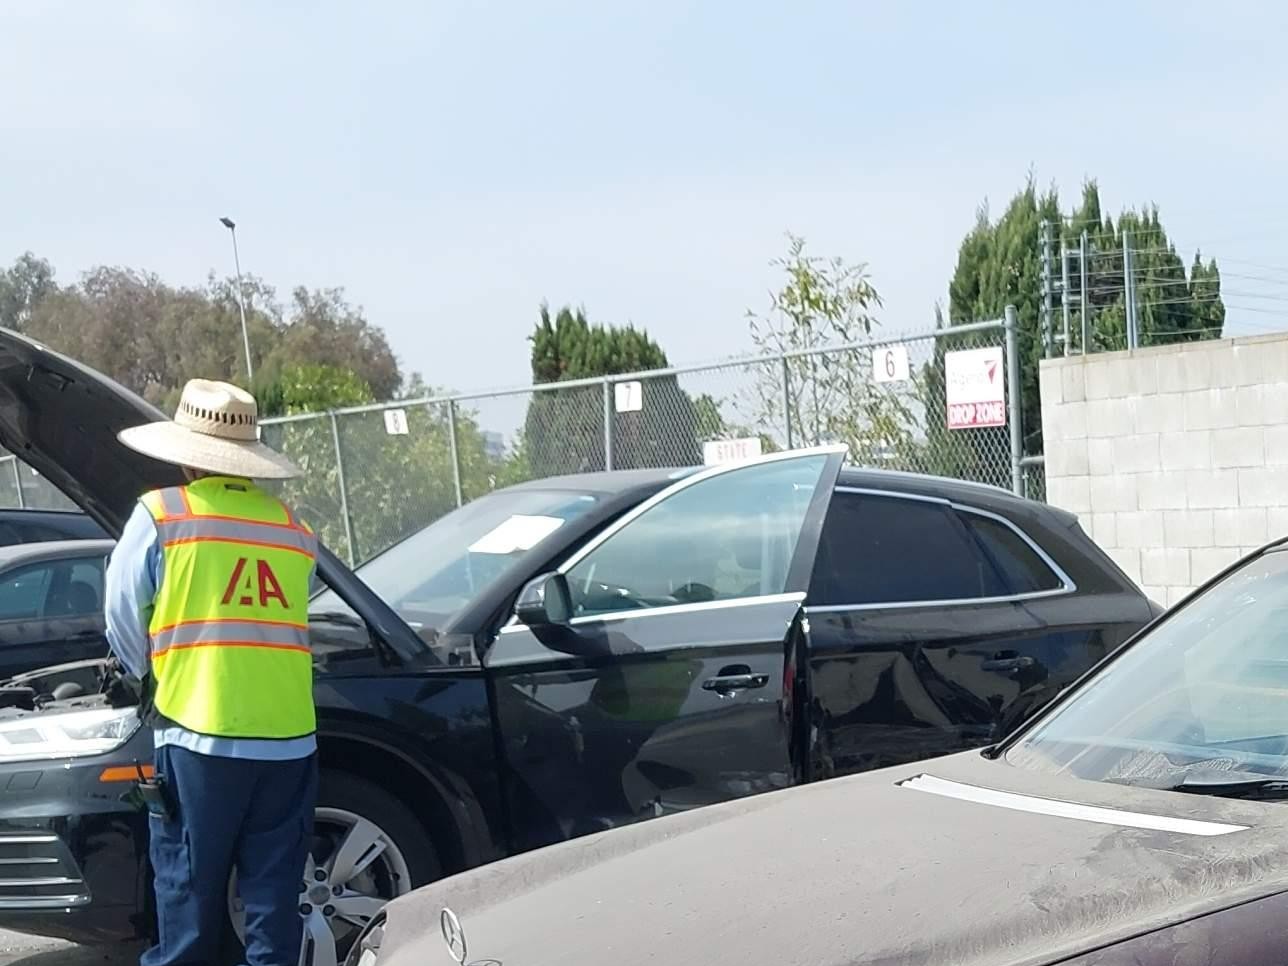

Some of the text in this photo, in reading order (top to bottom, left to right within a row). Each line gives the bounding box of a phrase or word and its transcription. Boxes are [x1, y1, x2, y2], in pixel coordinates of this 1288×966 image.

[886, 350, 895, 378] 6
[950, 402, 1002, 425] DROP ZONE
